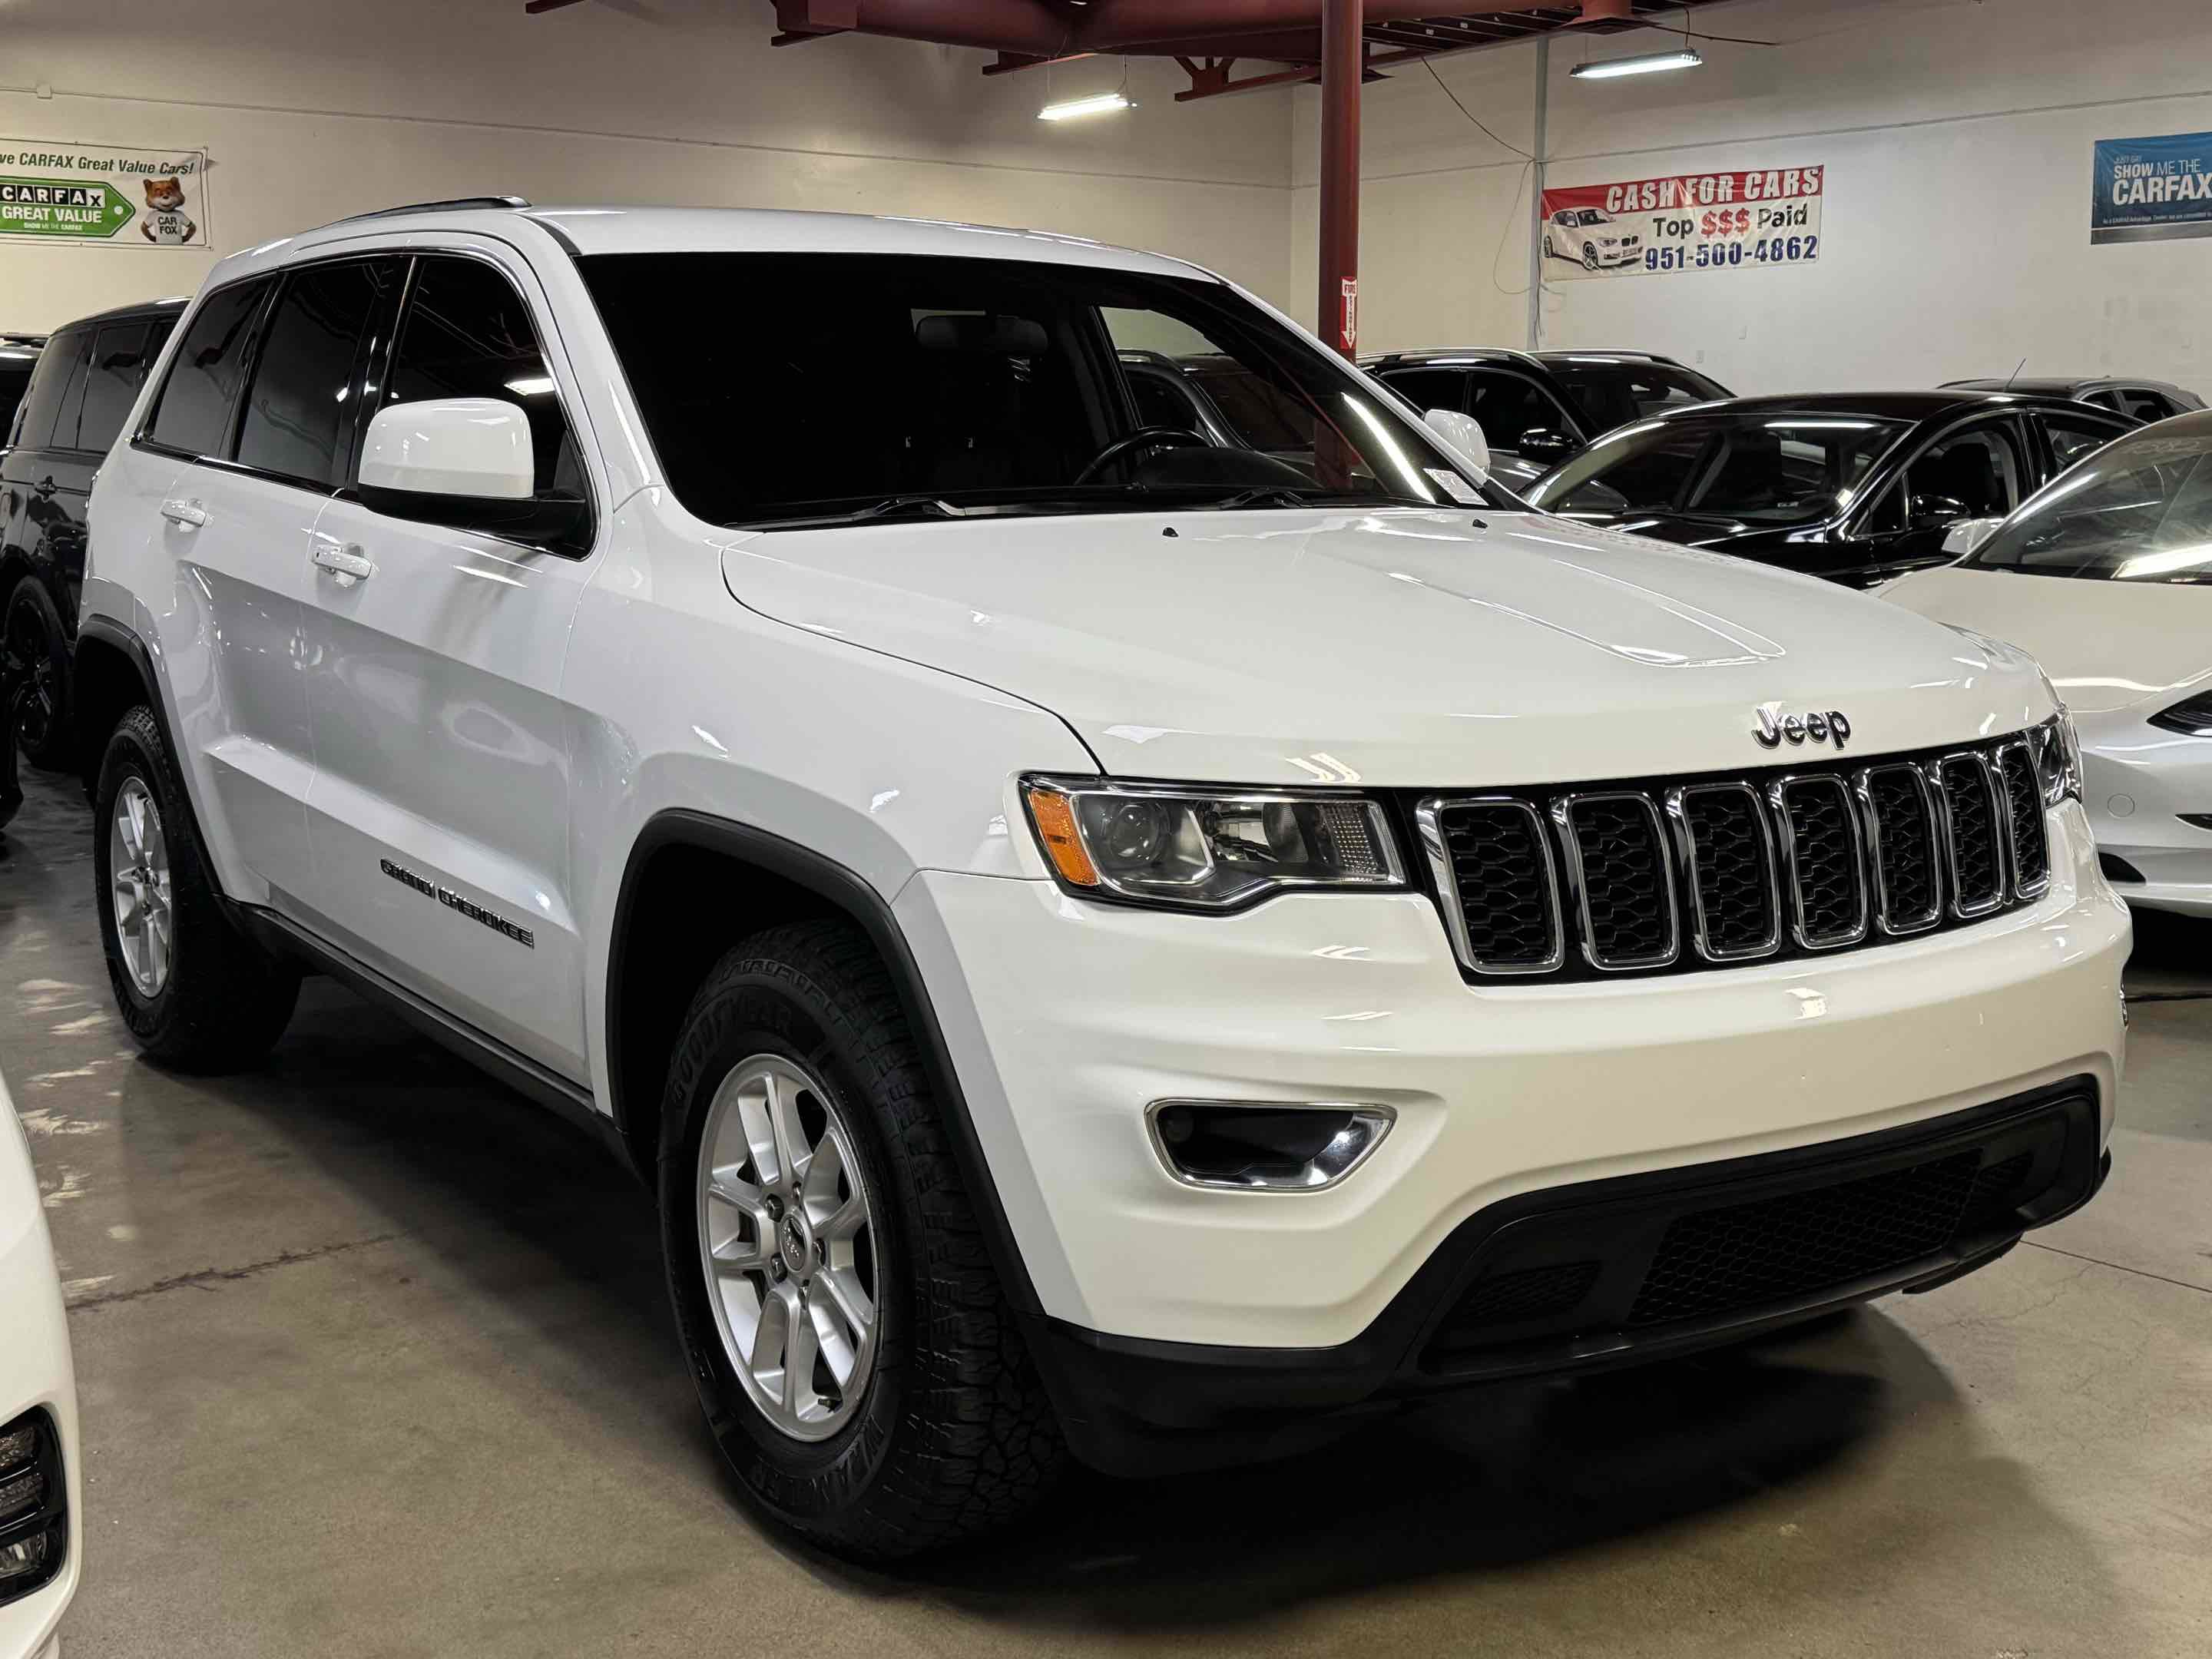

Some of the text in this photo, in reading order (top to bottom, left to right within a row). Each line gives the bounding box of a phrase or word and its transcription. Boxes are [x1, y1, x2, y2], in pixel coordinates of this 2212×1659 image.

[19, 152, 74, 168] CARFAX
[78, 157, 114, 171] Great
[118, 159, 155, 174] Value
[159, 162, 194, 175] Cars!
[2114, 158, 2200, 179] SHOW ME THE
[2, 186, 102, 207] CARFAX
[1606, 168, 1820, 213] CASH FOR CARS
[2113, 172, 2212, 206] CARFAX
[2, 206, 102, 224] GREAT VALUE
[157, 216, 177, 226] CAR
[1652, 204, 1808, 242] Top $$$ Paid
[159, 225, 177, 234] FOX
[1645, 234, 1819, 271] 951-500-4862
[1751, 702, 1851, 750] Jeep
[380, 858, 535, 949] GRAND CHEROKEE
